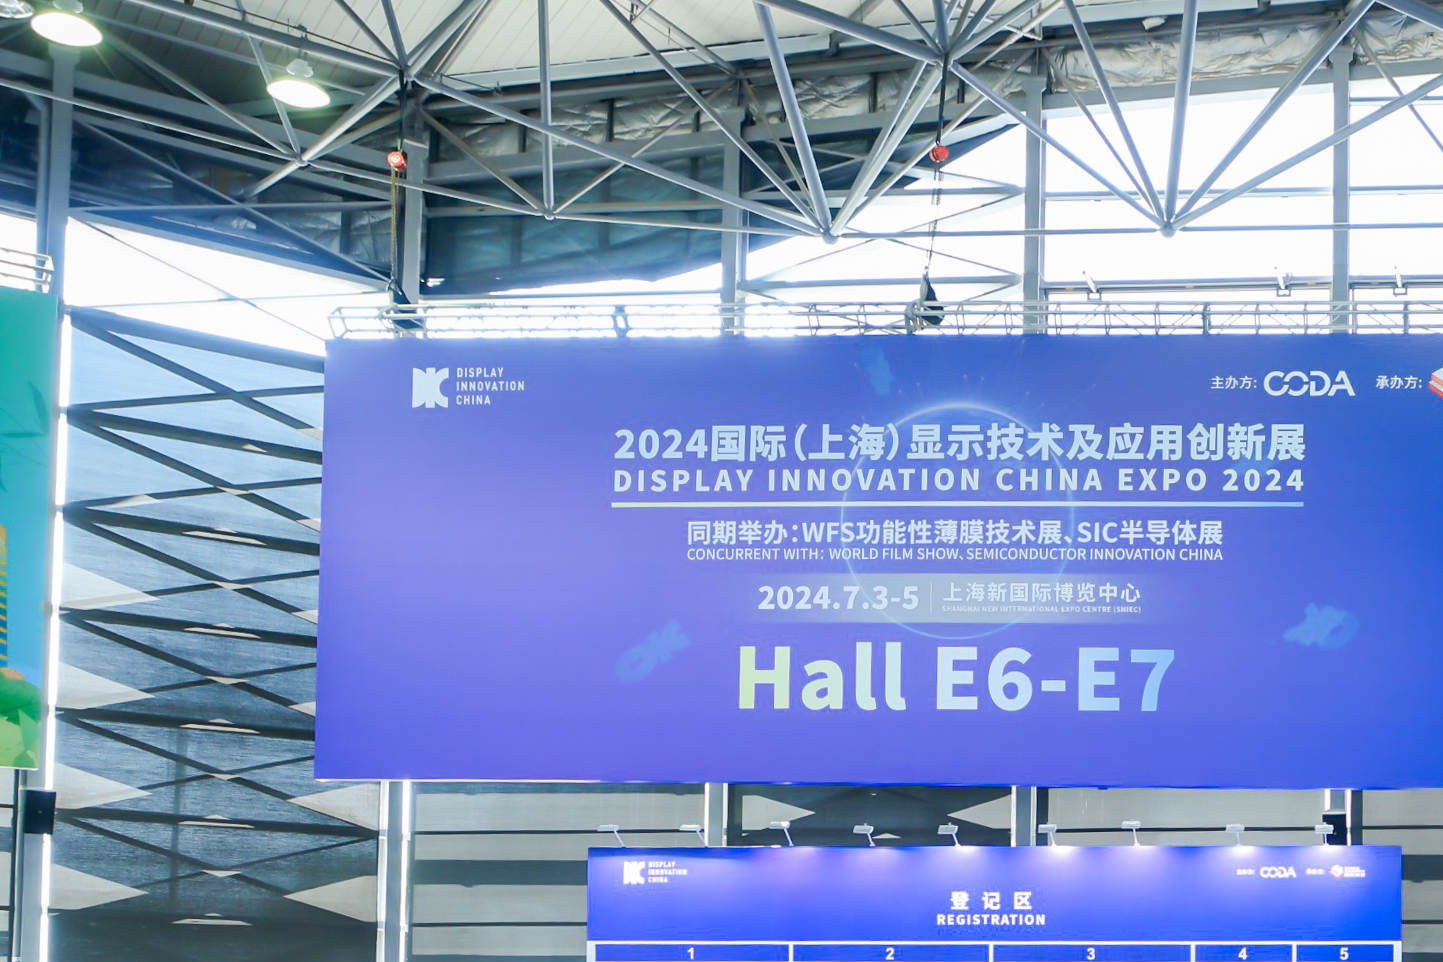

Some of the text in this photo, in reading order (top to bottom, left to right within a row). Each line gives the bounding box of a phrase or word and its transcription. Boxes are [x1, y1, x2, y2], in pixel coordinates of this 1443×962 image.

[456, 367, 504, 378] DISPLAY
[456, 380, 525, 391] INNOVATION
[1263, 370, 1355, 396] CODA
[456, 395, 491, 405] CHINA
[614, 423, 1305, 462] 2024国际（上海）显示技术及应用创新展
[613, 467, 1305, 493] DISPLAY INNOVATION CHINA EXPO 2024
[687, 548, 776, 561] CONCURRENT
[779, 548, 824, 561] WITH:
[829, 548, 878, 561] WORLD
[882, 548, 912, 561] FILM
[1090, 548, 1175, 561] INNOVATION
[1179, 548, 1223, 561] CHINA
[758, 585, 919, 611] 2024.7.3-5
[943, 582, 1141, 603] 上海新国际博览中心
[1000, 605, 1059, 613] INTERNATIONAL
[1061, 605, 1081, 613] EXPO
[1082, 605, 1112, 613] CENTRE
[1113, 605, 1142, 614] (SNIEC)
[738, 641, 1176, 713] Hall E6-E7
[950, 891, 1033, 910] 登记区
[937, 914, 1046, 926] REGISTRATION
[687, 948, 695, 960] 1
[885, 947, 895, 960] 2
[1086, 948, 1096, 960] 3
[1238, 948, 1248, 960] 4
[1339, 948, 1349, 960] 5
